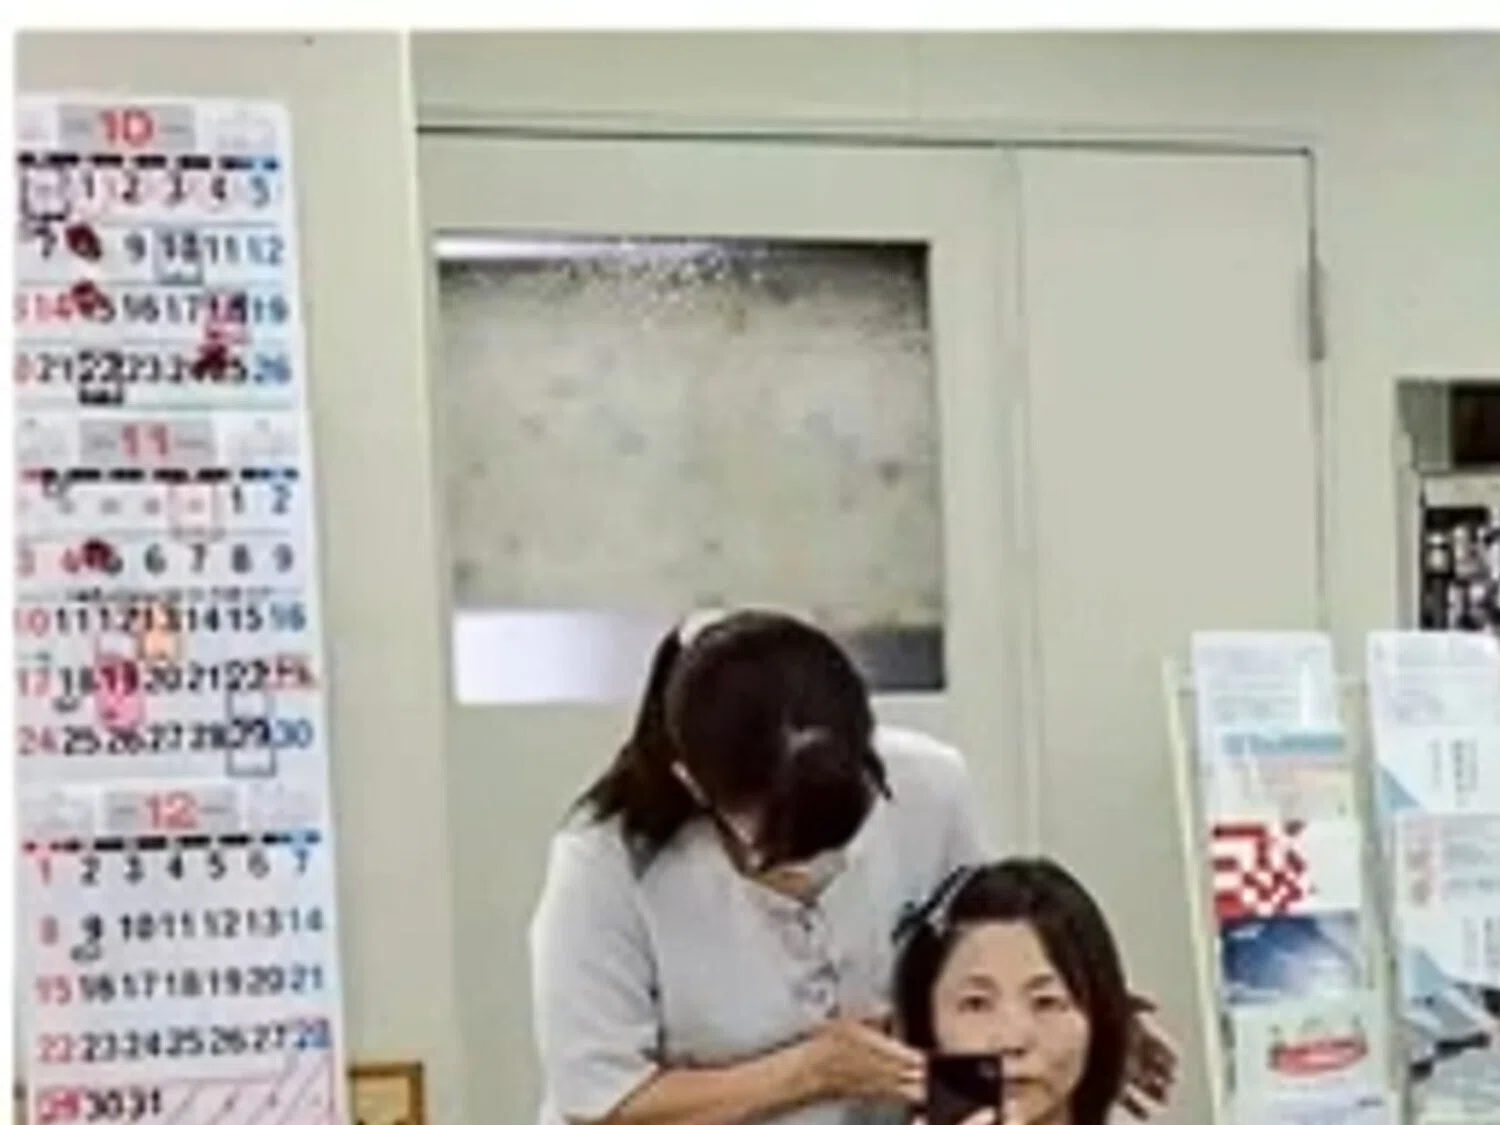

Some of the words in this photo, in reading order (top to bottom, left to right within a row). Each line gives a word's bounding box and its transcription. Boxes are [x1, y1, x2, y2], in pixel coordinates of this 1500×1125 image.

[100, 106, 155, 148] 10
[121, 423, 170, 458] 11
[147, 790, 198, 831] 12
[38, 857, 52, 887] 1
[79, 853, 101, 886] 2
[123, 853, 146, 885] 3
[167, 851, 184, 881] 4
[206, 850, 227, 881] 5
[248, 849, 271, 880] 6
[292, 845, 312, 875] 7
[39, 914, 60, 947] 8
[81, 914, 104, 945] 9
[119, 911, 155, 942] 10
[159, 908, 196, 939] 11
[203, 906, 241, 938] 12
[247, 905, 284, 938] 13
[289, 905, 325, 933] 14
[36, 974, 73, 1005] 15
[79, 973, 117, 1004] 16
[121, 969, 158, 1001] 17
[164, 968, 203, 999] 18
[209, 967, 243, 998] 19
[247, 964, 286, 997] 20
[290, 963, 324, 991] 21
